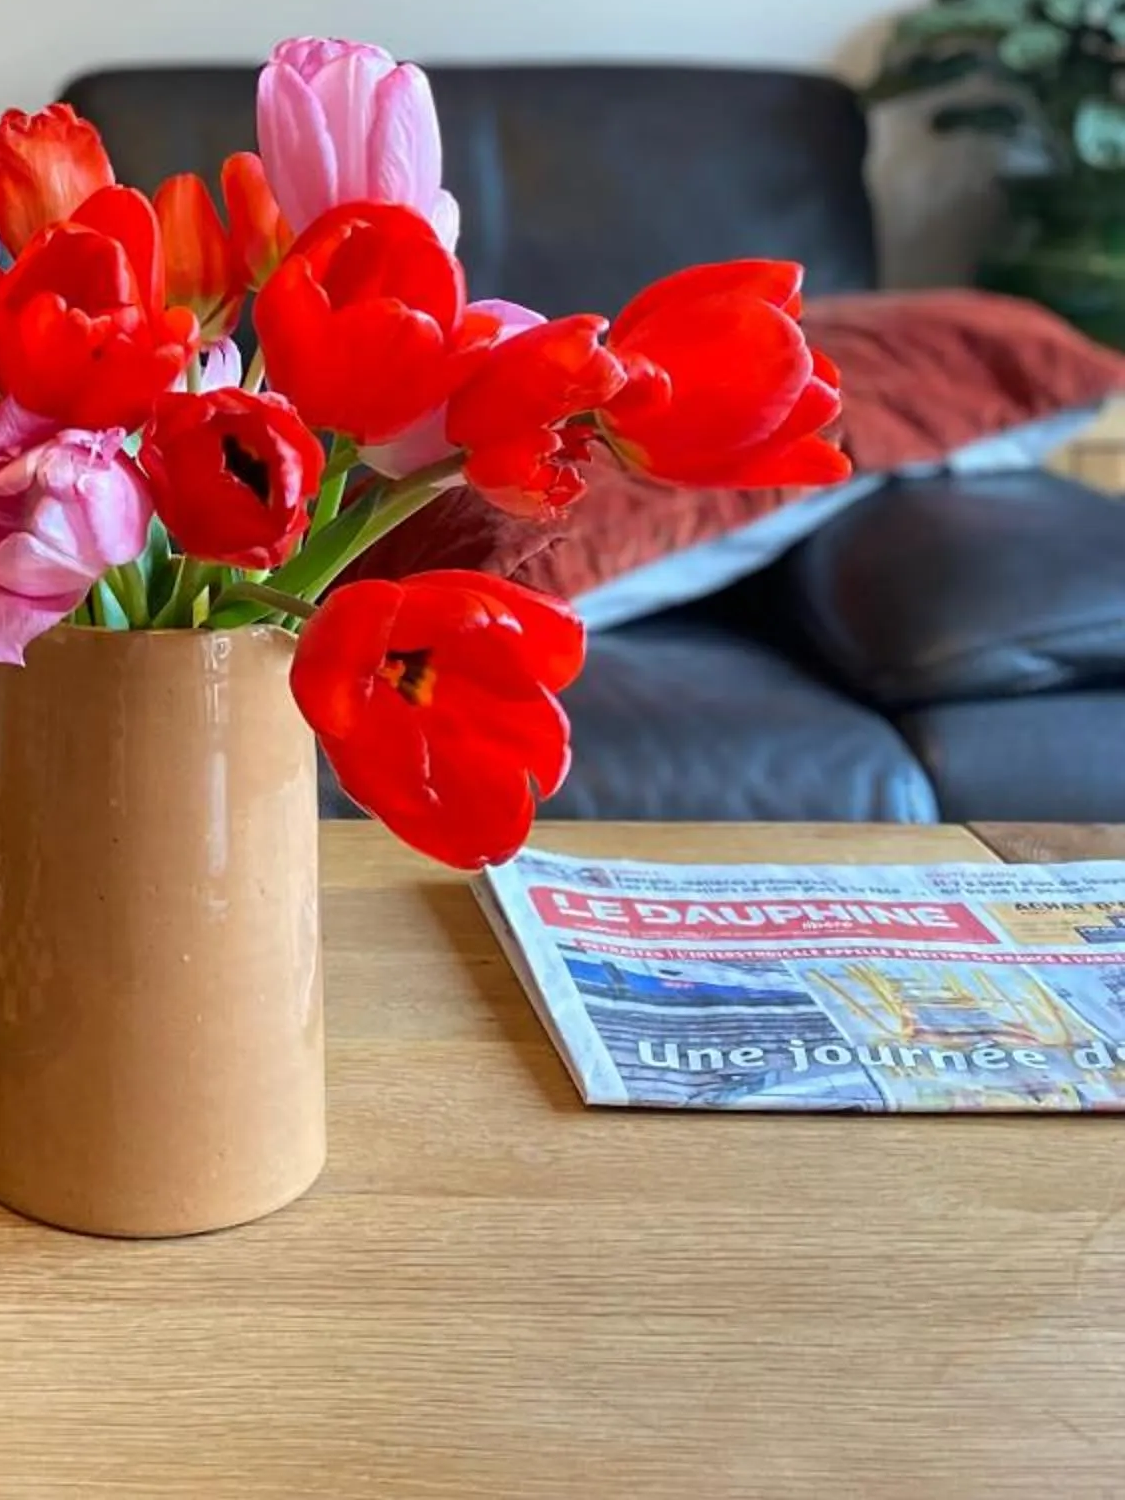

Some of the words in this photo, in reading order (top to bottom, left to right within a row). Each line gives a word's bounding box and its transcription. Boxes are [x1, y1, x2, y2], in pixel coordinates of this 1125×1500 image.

[552, 893, 630, 923] LE
[638, 1040, 765, 1071] Une
[788, 1039, 1049, 1072] journée
